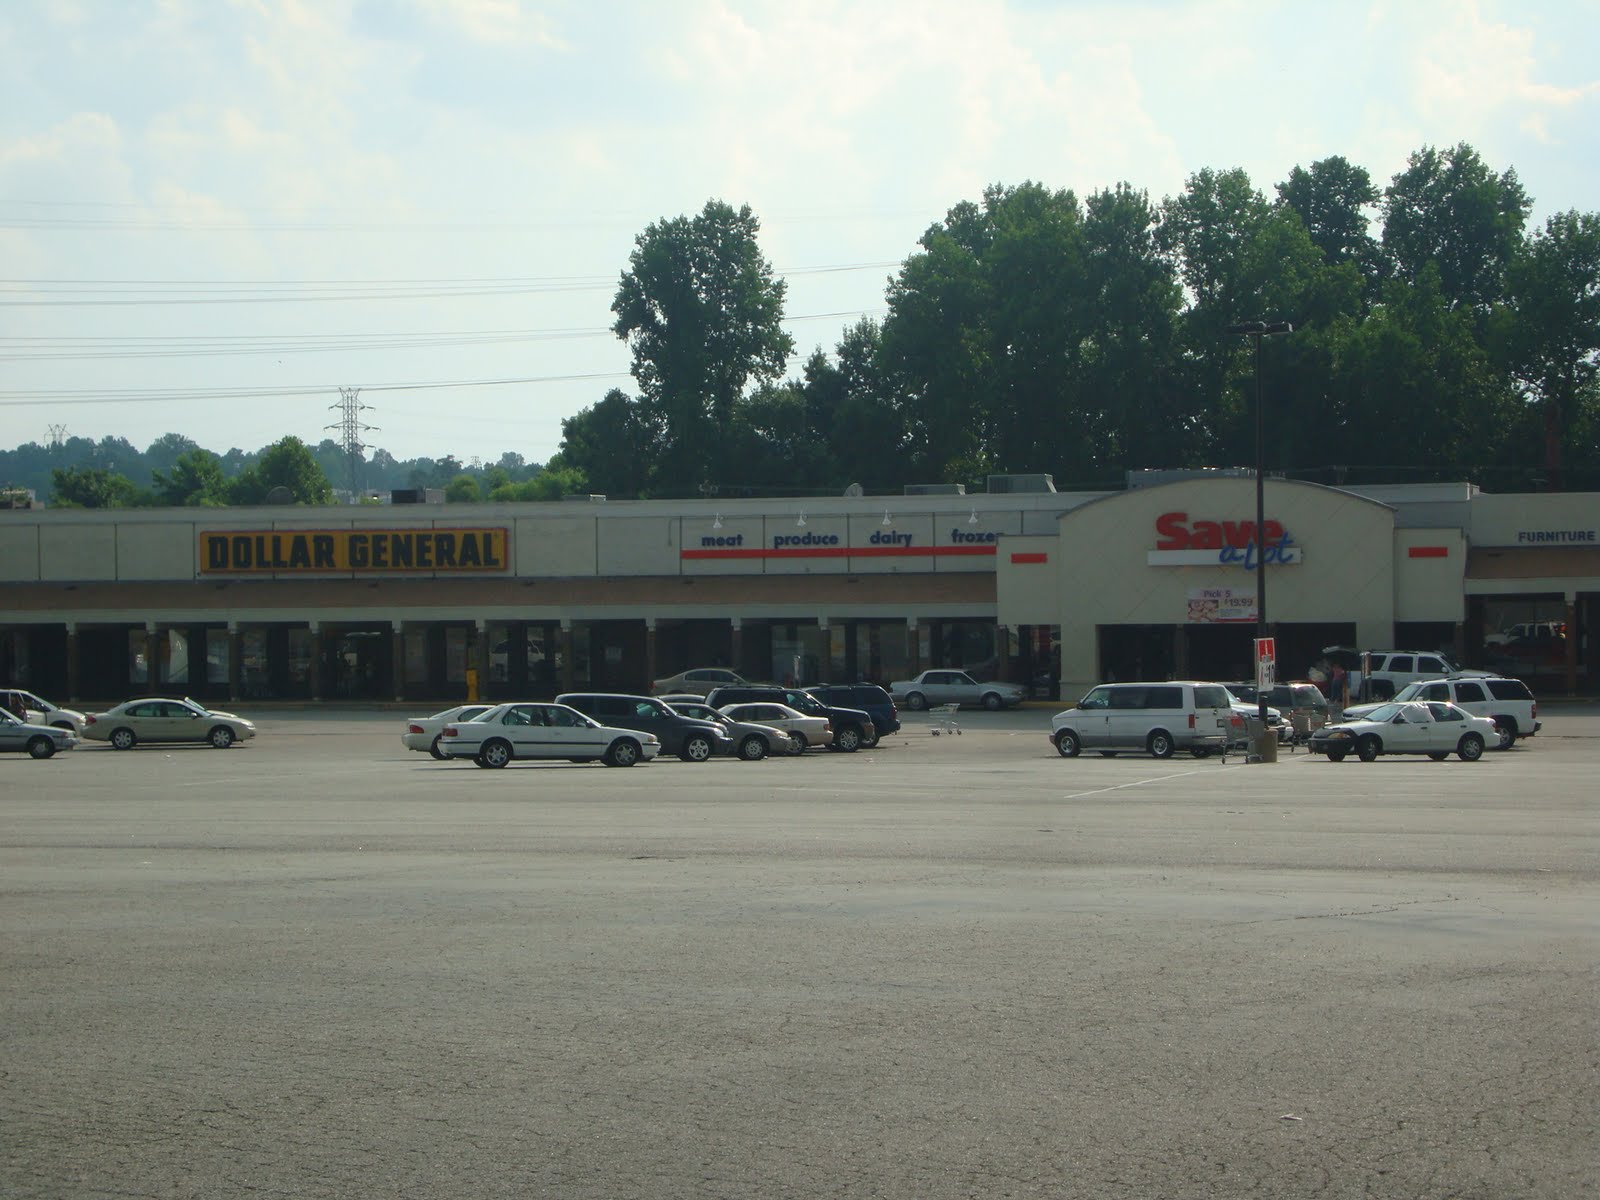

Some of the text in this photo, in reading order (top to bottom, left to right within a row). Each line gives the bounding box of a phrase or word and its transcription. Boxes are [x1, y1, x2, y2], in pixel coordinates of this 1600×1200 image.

[869, 530, 912, 548] dairy
[951, 528, 1002, 543] froze
[1156, 512, 1284, 551] Save
[1518, 530, 1596, 542] FURNITURE
[701, 533, 743, 547] meat
[774, 531, 839, 549] produce
[208, 533, 500, 568] DOLLAR GENERAL
[1203, 589, 1231, 598] Pick 5
